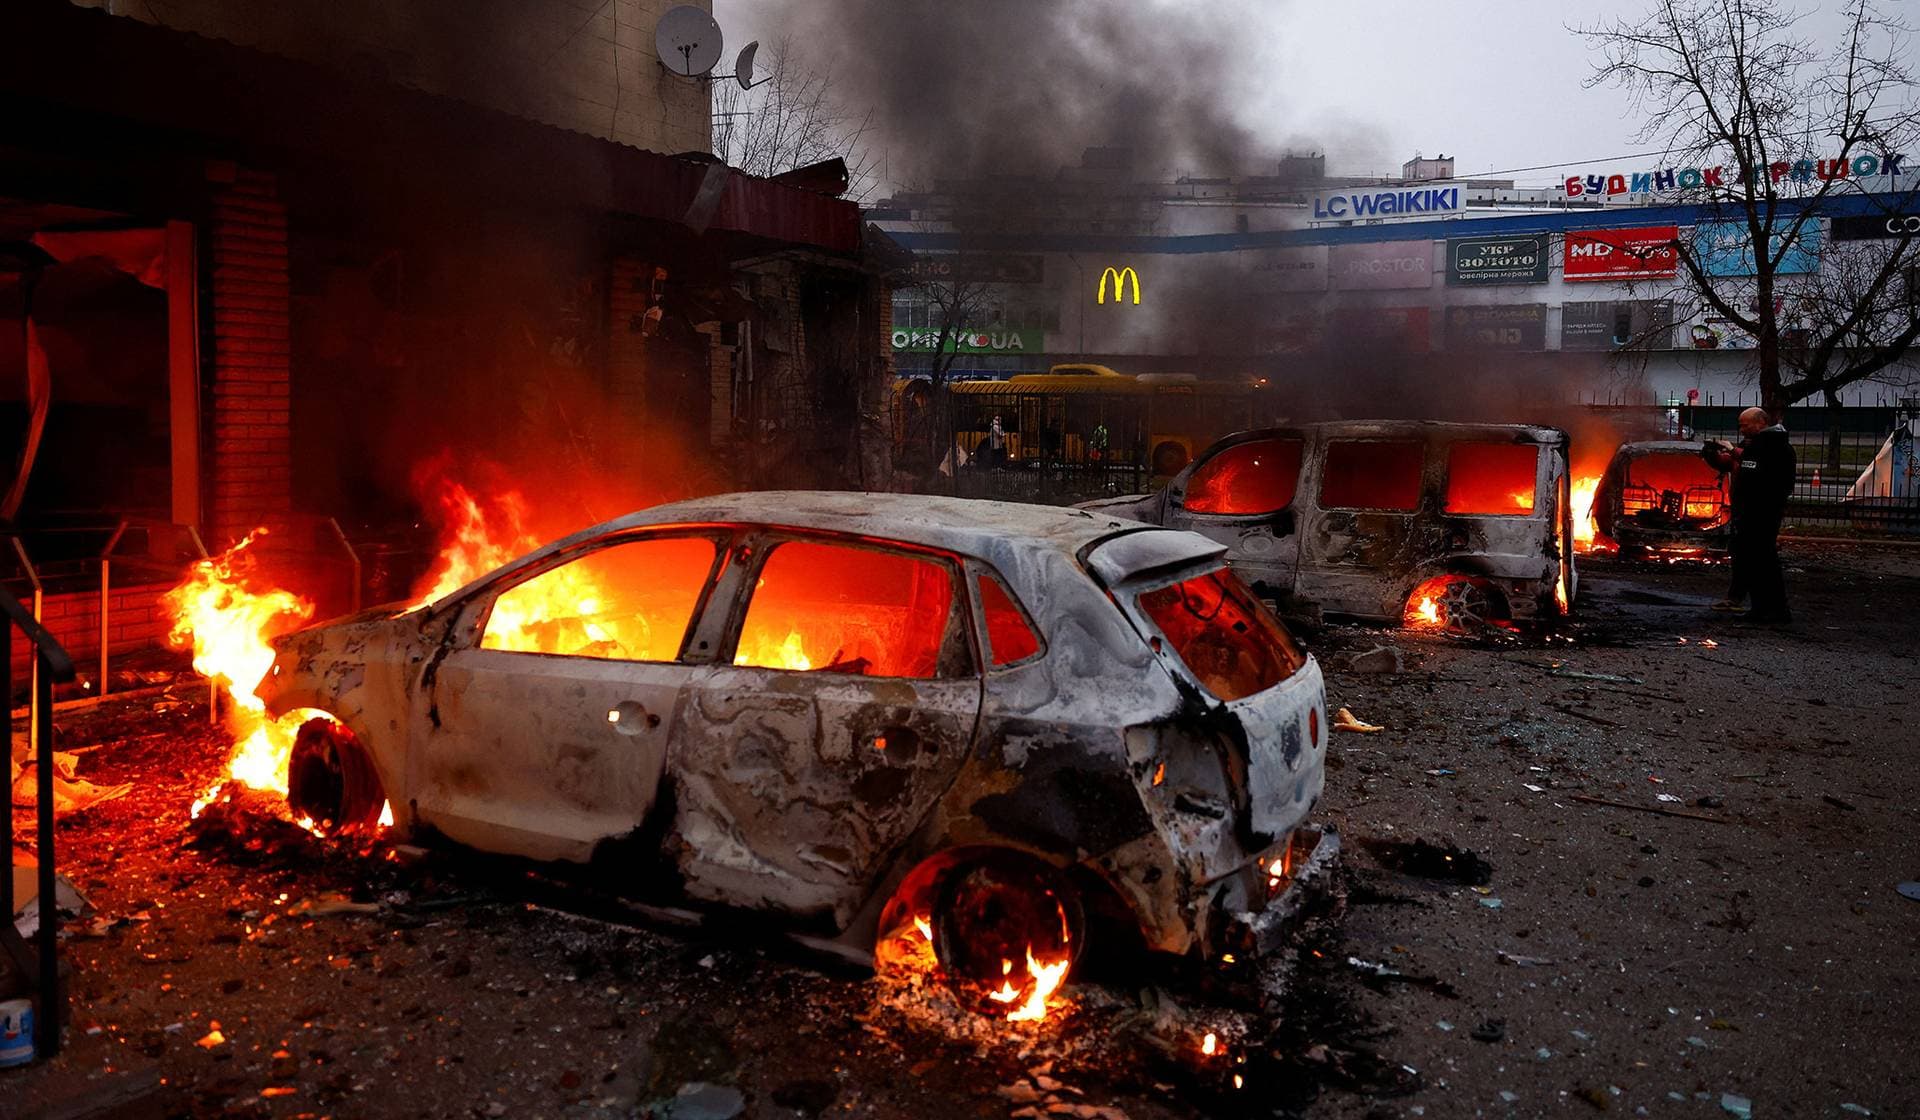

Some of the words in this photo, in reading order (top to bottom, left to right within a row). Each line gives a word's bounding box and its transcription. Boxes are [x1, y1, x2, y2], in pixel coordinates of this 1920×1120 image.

[1565, 165, 1725, 198] БУДИНОК
[1314, 196, 1347, 219] LC
[1479, 245, 1515, 256] УКР
[1571, 242, 1614, 257] MD
[1349, 257, 1425, 273] PROSTOR
[1460, 255, 1535, 268] ЗОЛОТО
